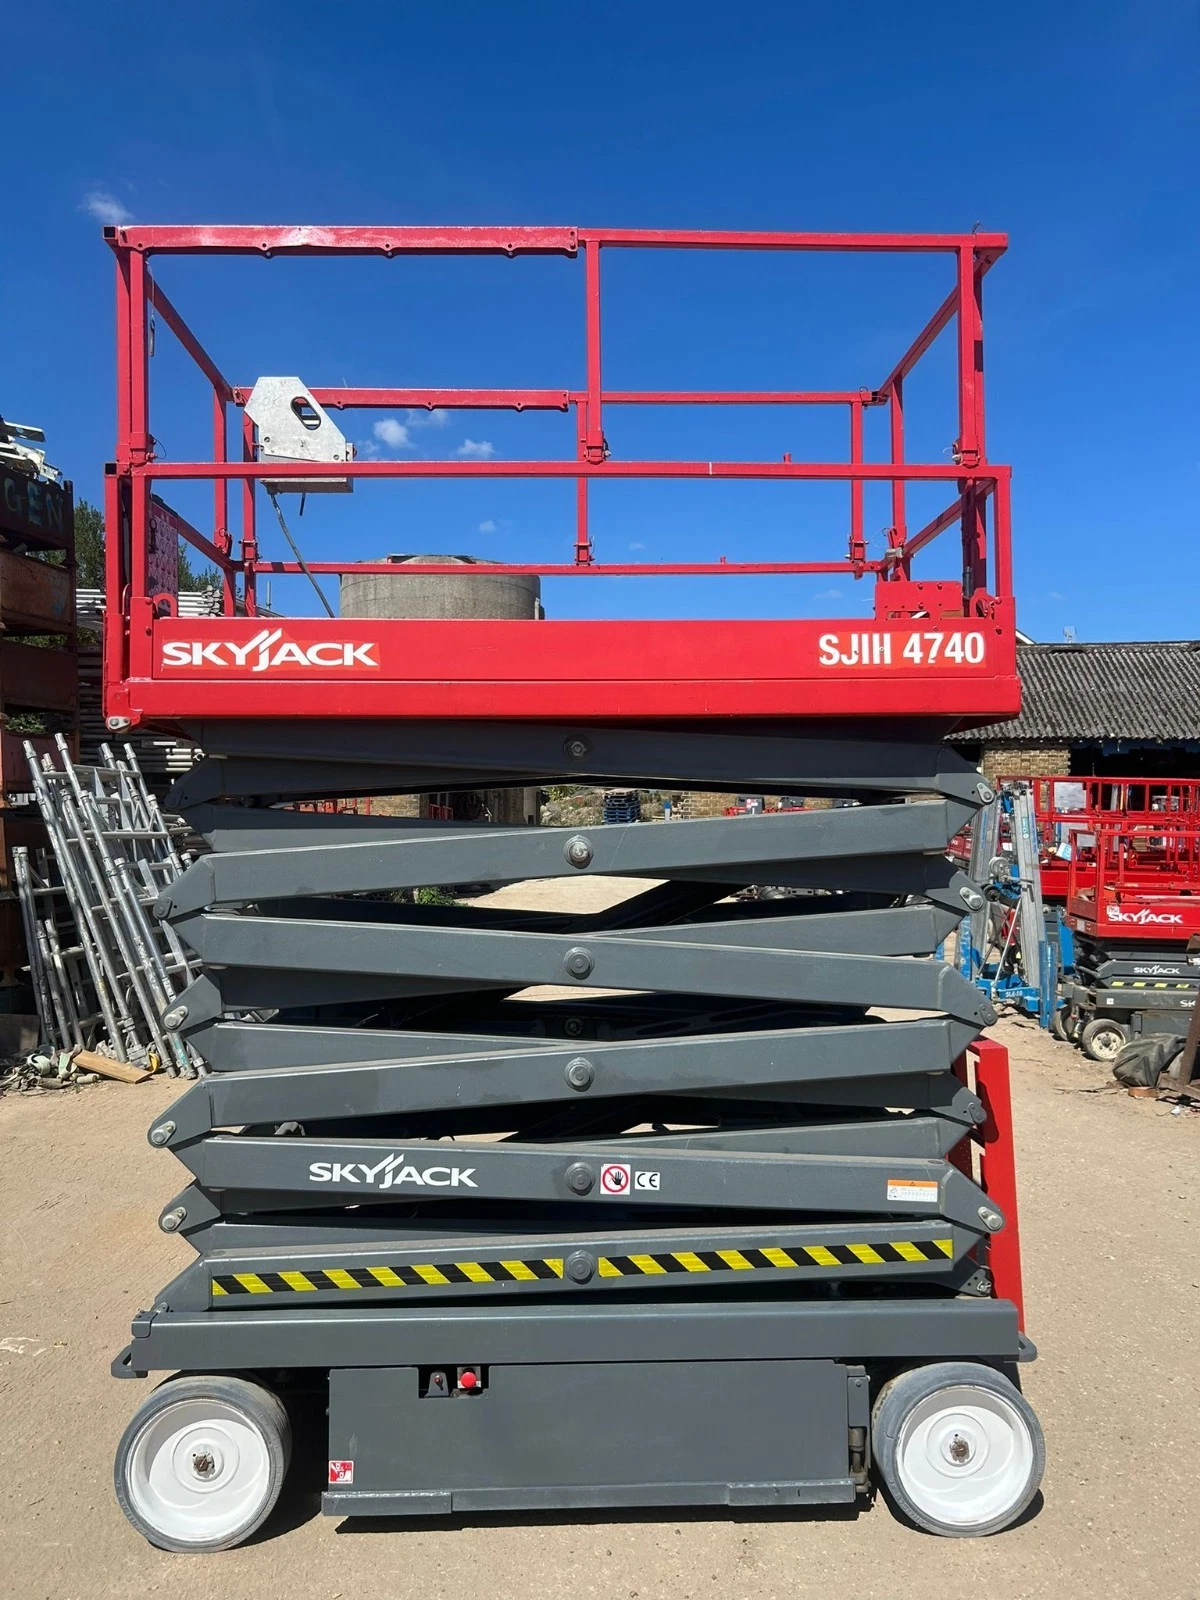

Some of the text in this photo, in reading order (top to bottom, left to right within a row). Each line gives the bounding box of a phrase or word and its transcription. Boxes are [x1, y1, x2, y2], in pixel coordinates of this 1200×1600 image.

[162, 628, 378, 672] SKYJACK
[902, 632, 985, 664] 4740
[1107, 908, 1183, 925] SKYJACK
[1133, 965, 1181, 975] SKYJACK
[308, 1153, 479, 1190] SKYJACK
[636, 1173, 659, 1188] CE
